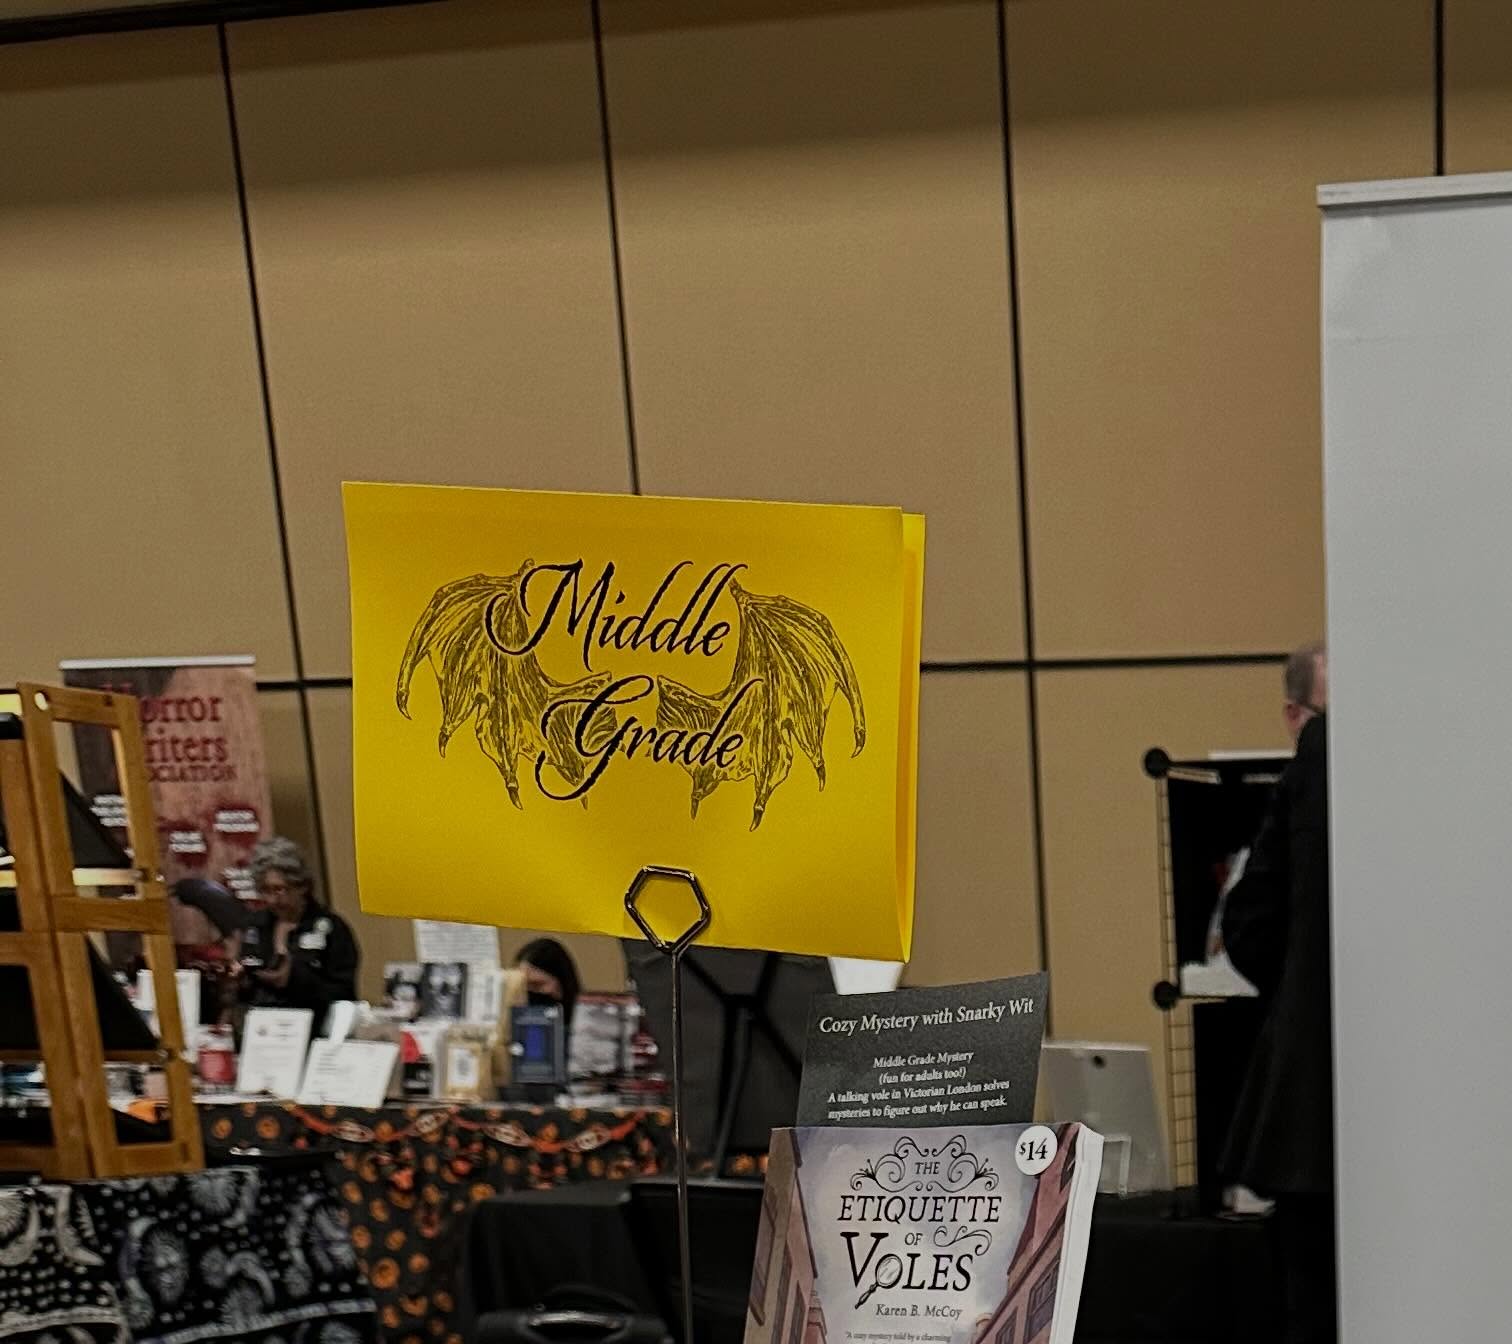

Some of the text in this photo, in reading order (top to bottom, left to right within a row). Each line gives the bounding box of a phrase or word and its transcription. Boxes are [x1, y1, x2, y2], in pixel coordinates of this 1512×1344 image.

[486, 558, 747, 671] Middle
[535, 675, 763, 800] Grade
[819, 998, 1034, 1036] Cozy Mystery with Snarky Wit
[873, 1051, 975, 1069] Middle Grade Mystery
[879, 1072, 899, 1086] (fun
[900, 1071, 914, 1082] for
[915, 1068, 942, 1081] adults
[827, 1079, 1010, 1105] A talking vole in Victorian London solves
[828, 1106, 870, 1121] mysteries
[872, 1107, 882, 1117] to
[883, 1104, 910, 1118] figure
[911, 1103, 928, 1114] out
[929, 1101, 949, 1116] why
[949, 1099, 961, 1112] he
[962, 1100, 979, 1110] can
[1018, 1137, 1049, 1162] $14
[914, 1160, 940, 1176] THE
[837, 1194, 1002, 1224] ETIQUETTE
[904, 1231, 923, 1247] OF
[876, 1303, 964, 1321] Karen B. McCoy
